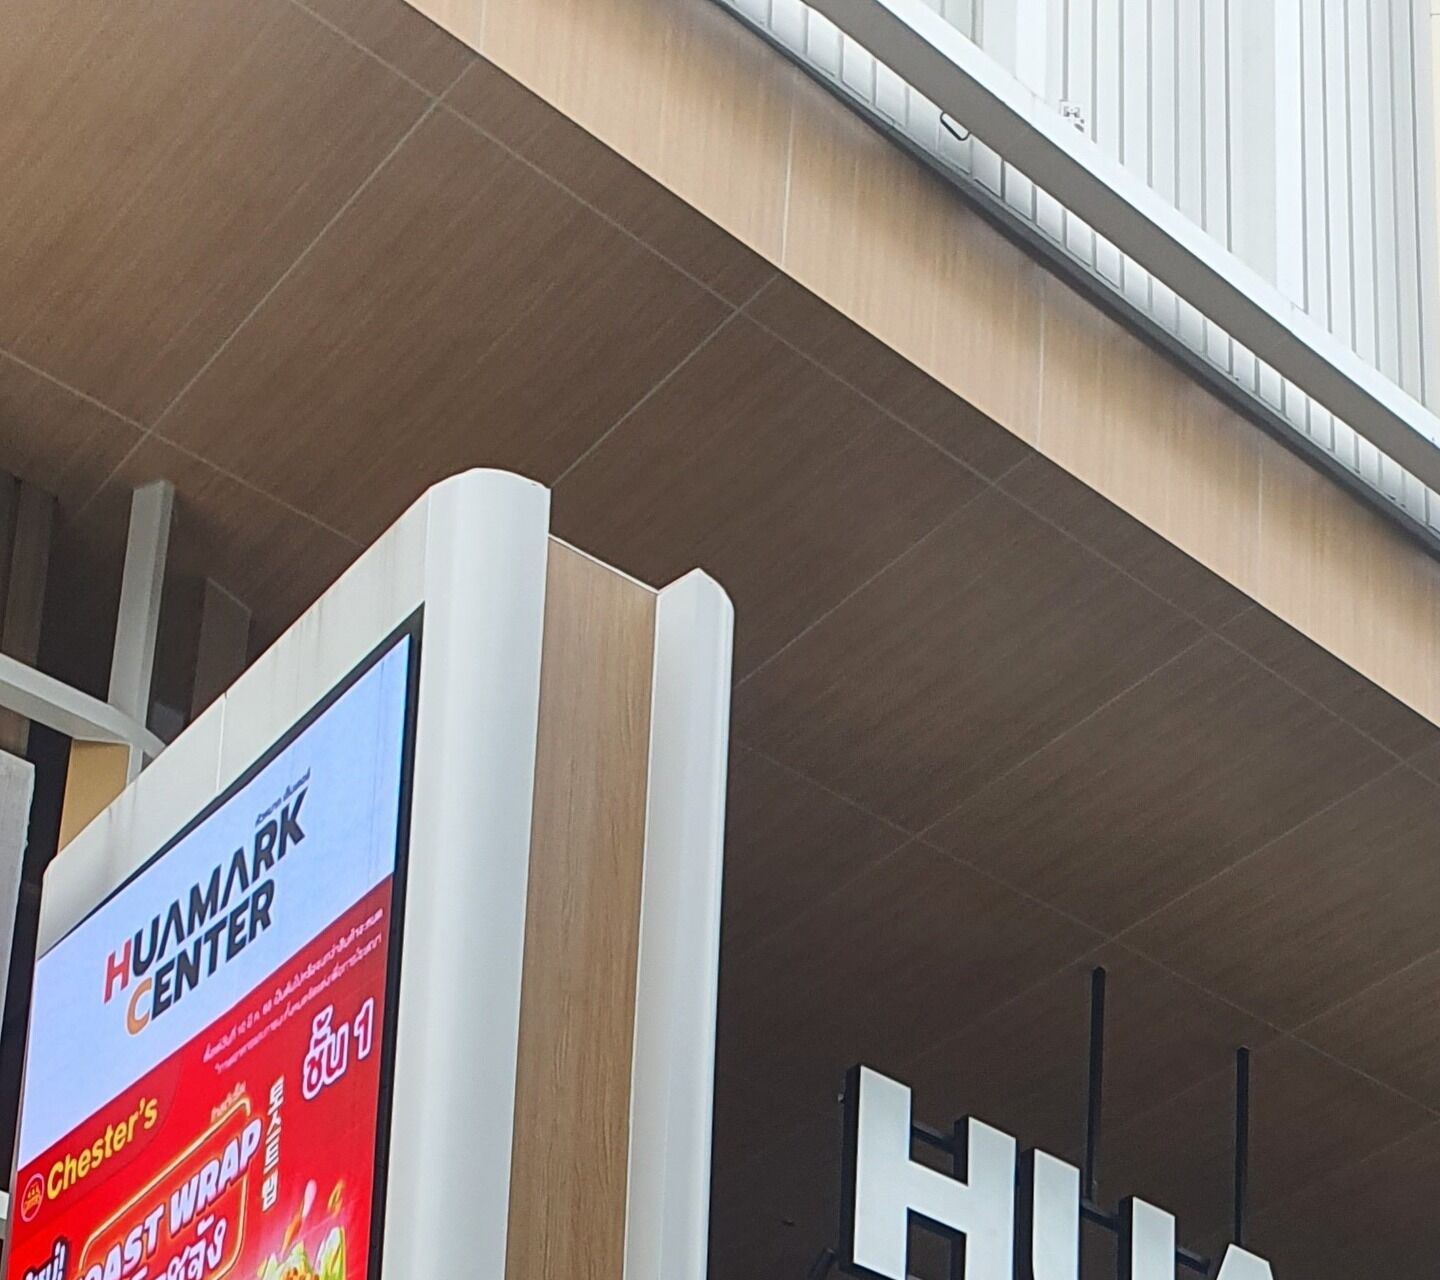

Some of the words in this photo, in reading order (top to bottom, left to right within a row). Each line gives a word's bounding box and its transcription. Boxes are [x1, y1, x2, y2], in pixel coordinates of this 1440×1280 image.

[104, 785, 309, 1003] HUAMARK
[126, 879, 275, 1035] CENTER
[355, 997, 375, 1060] 1
[47, 1097, 158, 1200] Chester's
[170, 1118, 262, 1235] WRAP
